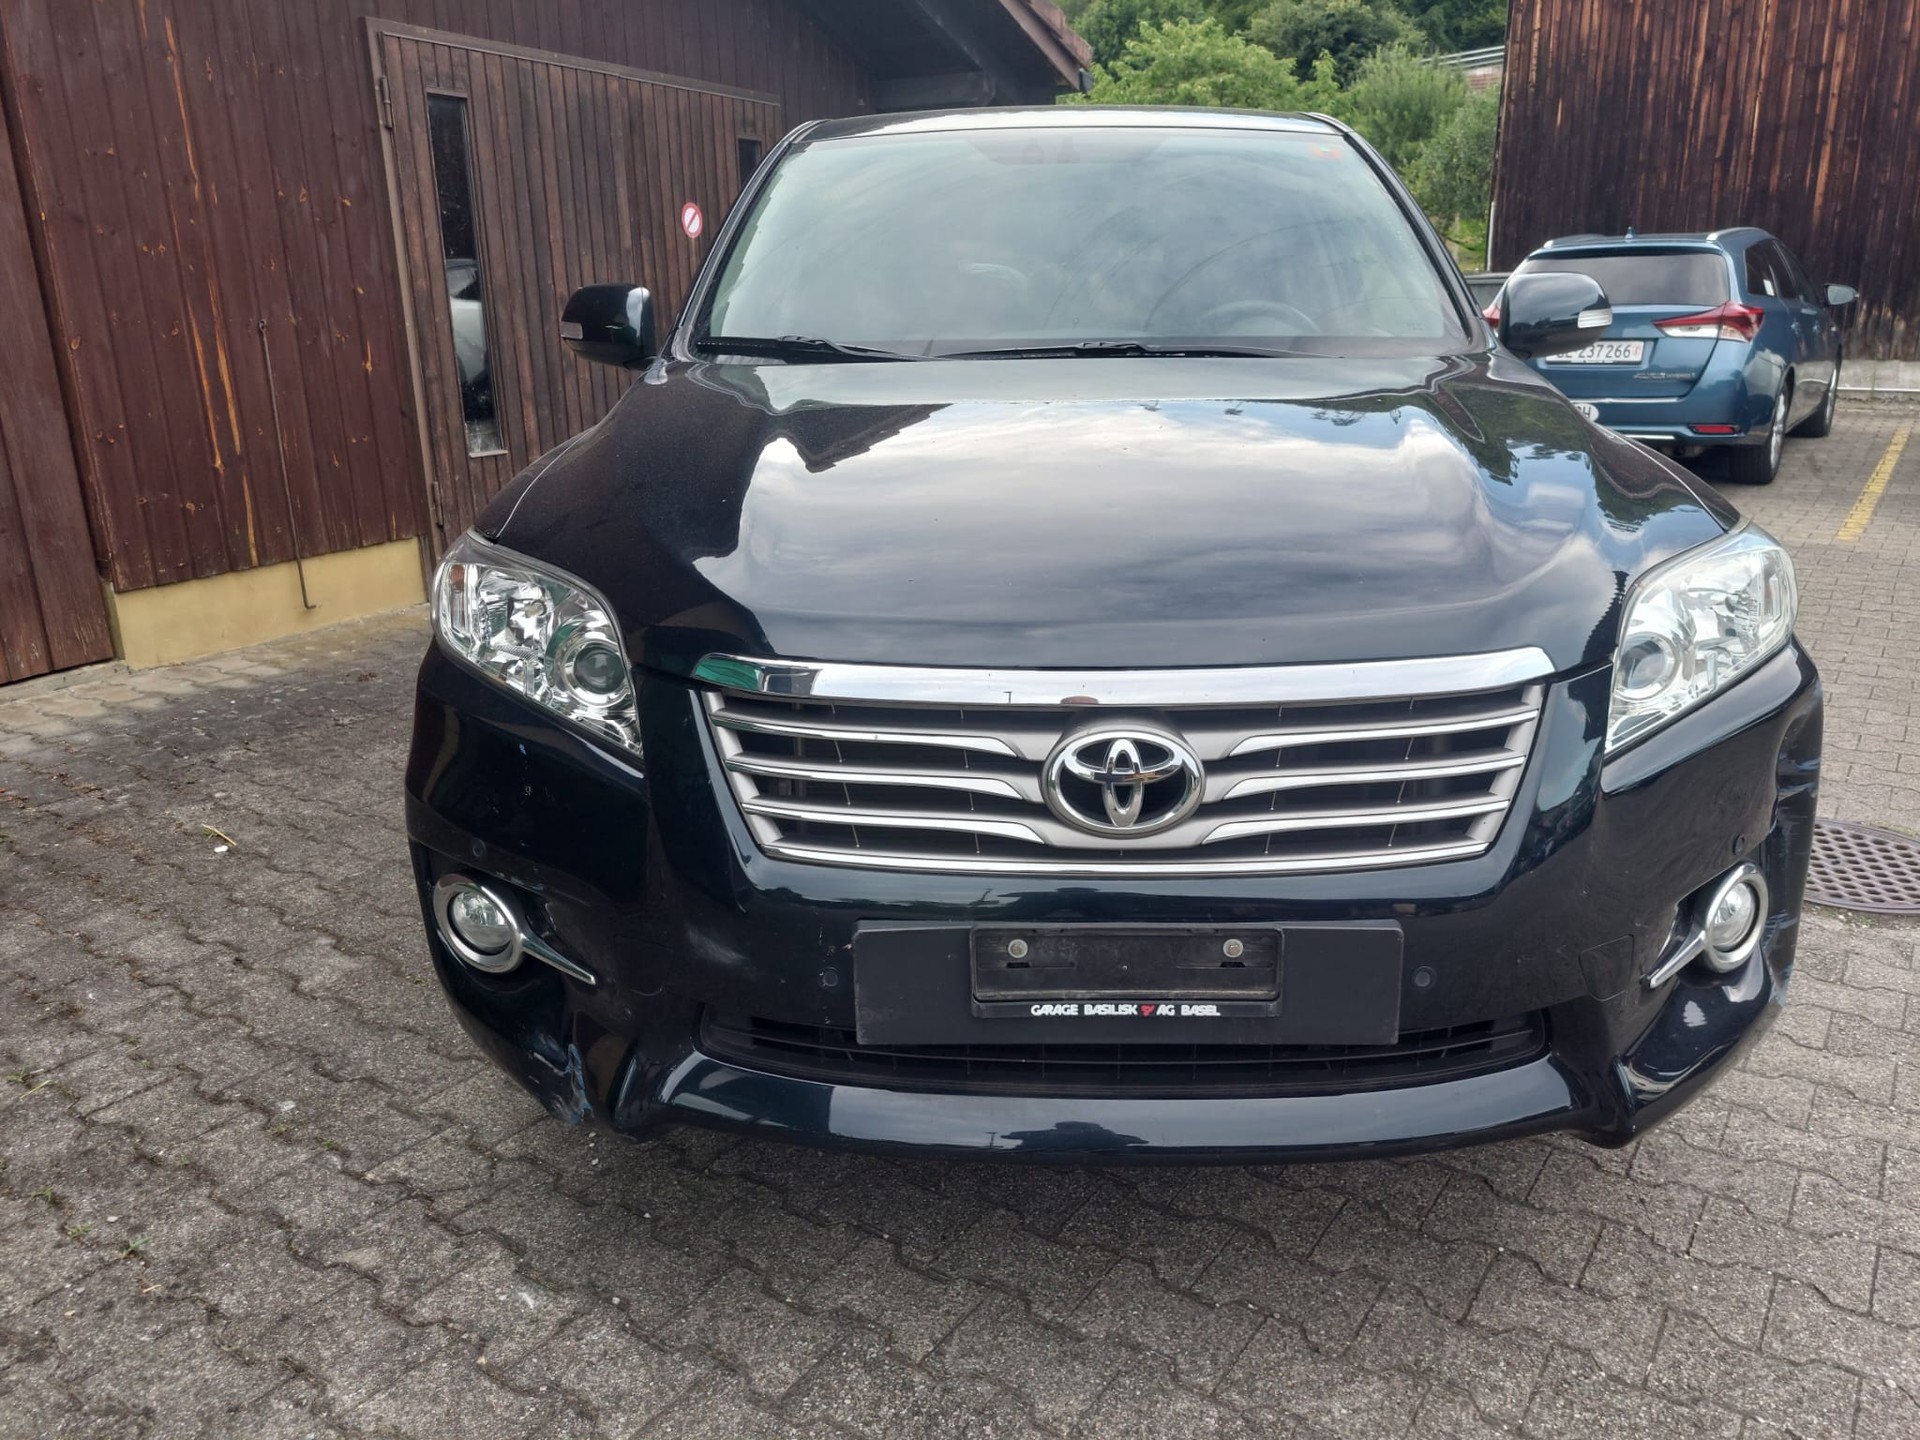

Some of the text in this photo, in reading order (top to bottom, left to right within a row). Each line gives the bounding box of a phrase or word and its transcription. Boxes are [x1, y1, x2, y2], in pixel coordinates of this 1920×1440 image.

[1031, 1004, 1221, 1017] GARAGE BASILISK AG BASEL
